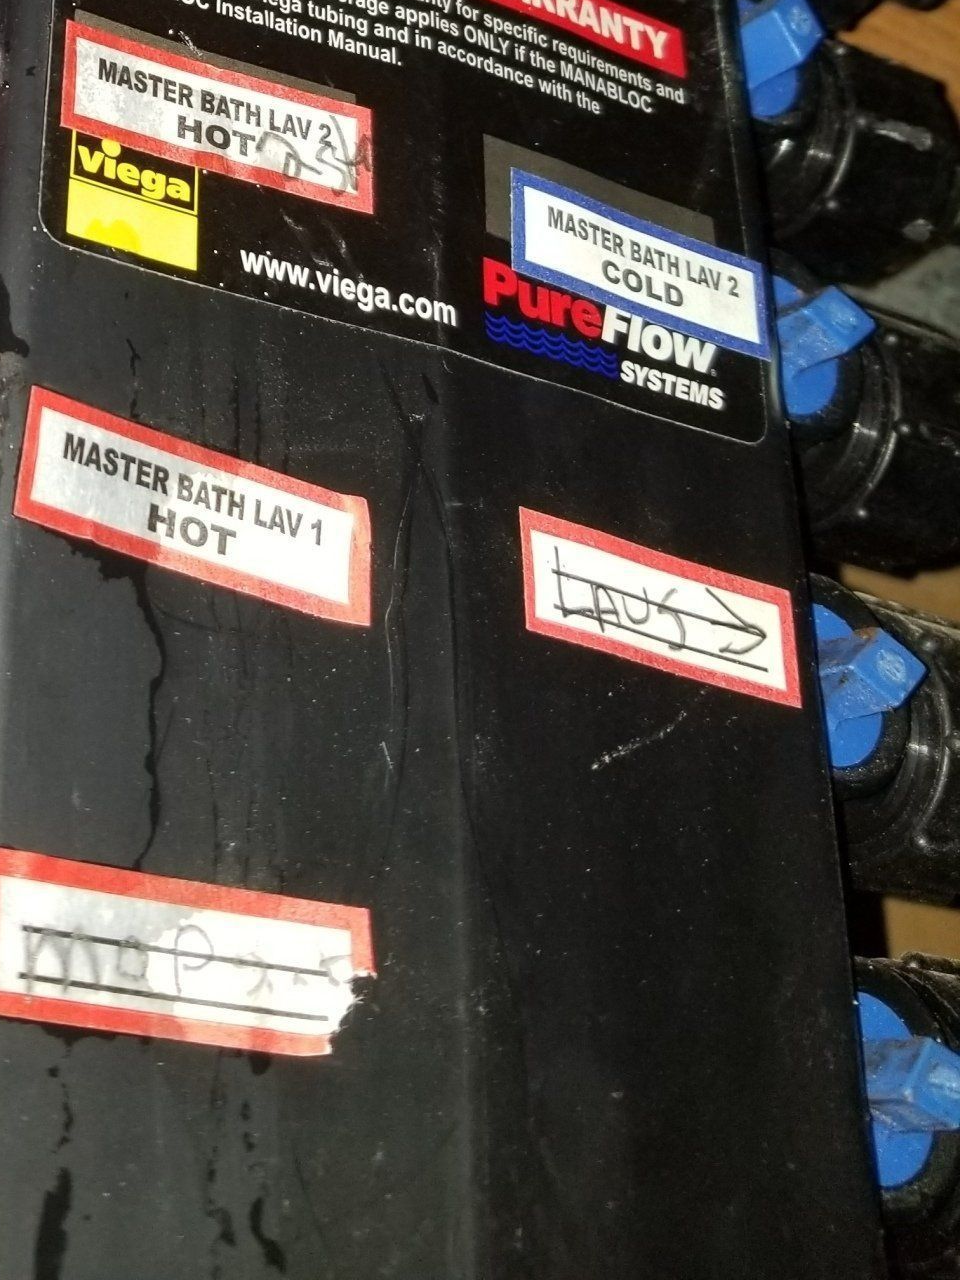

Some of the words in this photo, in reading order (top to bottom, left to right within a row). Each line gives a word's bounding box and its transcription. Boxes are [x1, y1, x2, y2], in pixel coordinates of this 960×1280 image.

[327, 28, 402, 67] Manual.
[374, 20, 408, 45] and
[415, 29, 432, 50] in
[437, 39, 533, 88] accordance
[538, 75, 572, 103] with
[576, 91, 600, 115] the
[395, 4, 458, 38] applies
[464, 24, 510, 56] ONLY
[515, 44, 526, 63] if
[530, 50, 556, 73] the
[560, 60, 653, 113] MANABLOC
[456, 0, 479, 21] for
[483, 12, 548, 48] specific
[552, 39, 652, 91] requirements
[656, 81, 686, 105] and
[98, 58, 193, 109] MASTER
[200, 90, 261, 127] BATH
[269, 108, 312, 140] LAV
[318, 123, 332, 145] 2
[177, 115, 256, 157] HOT
[78, 139, 191, 202] viega
[240, 249, 457, 327] www.viega.com
[547, 205, 625, 258] MASTER
[630, 239, 680, 278] BATH
[685, 259, 721, 291] LAV
[728, 275, 740, 297] 2
[601, 259, 684, 307] COLD
[620, 360, 725, 410] SYSTEMS
[63, 432, 170, 496] MASTER
[177, 473, 245, 521] BATH
[254, 499, 303, 538] LAV
[310, 519, 322, 546] 1
[148, 503, 236, 555] HOT
